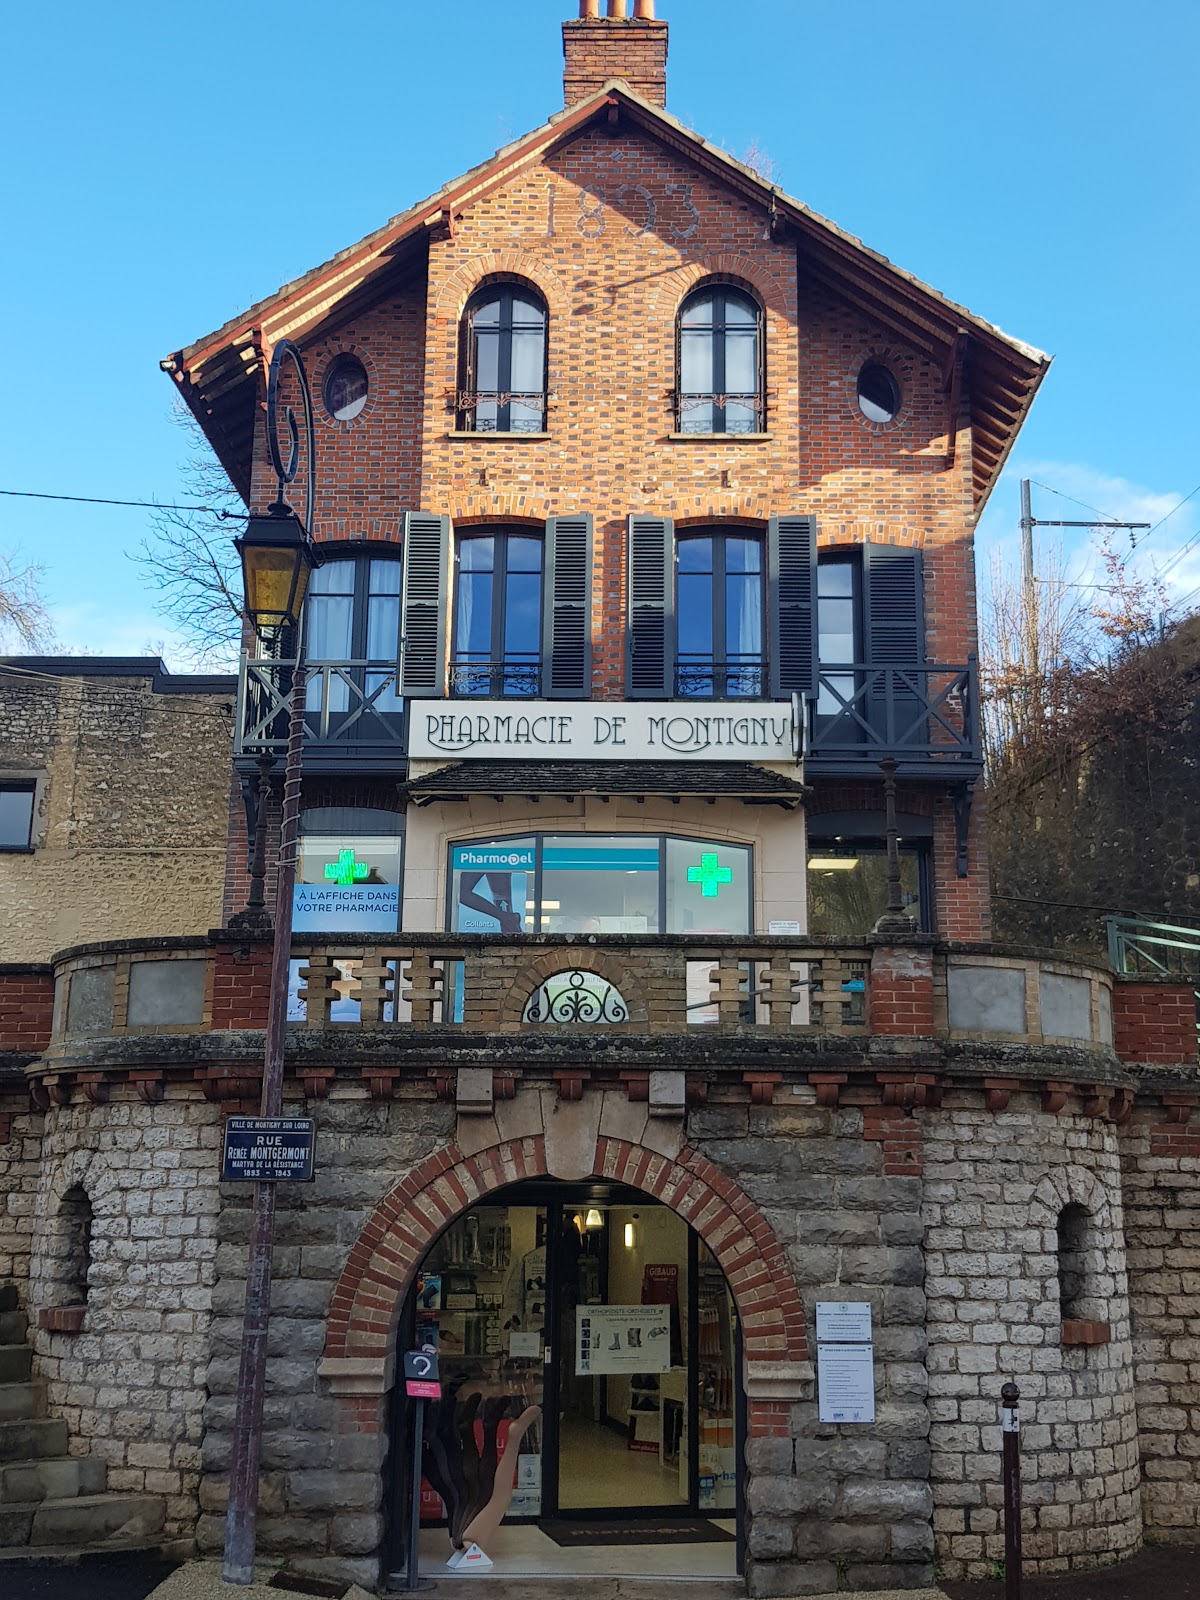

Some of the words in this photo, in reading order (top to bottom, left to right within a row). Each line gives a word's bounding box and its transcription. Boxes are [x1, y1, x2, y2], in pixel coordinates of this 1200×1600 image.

[425, 714, 573, 751] PHARMACIE
[593, 716, 627, 745] DE
[647, 716, 788, 754] MONTIGNY
[299, 889, 306, 900] À
[310, 891, 364, 900] L'AFFICHE
[367, 891, 397, 900] DANS
[296, 903, 332, 912] VOTRE
[335, 903, 399, 913] PHARMACIE
[231, 1120, 245, 1128] VILLE
[246, 1121, 254, 1129] DE
[254, 1121, 281, 1129] MONTIGNY
[294, 1122, 309, 1130] LOING
[256, 1136, 283, 1145] RUE
[250, 1147, 310, 1160] MONTGERMONT
[232, 1160, 254, 1168] MARTYR
[256, 1160, 263, 1168] DE
[265, 1160, 271, 1168] LA
[273, 1160, 304, 1168] RÉSISTANCE
[243, 1169, 260, 1177] 1893
[275, 1169, 291, 1177] 1943
[649, 1267, 677, 1276] GIBAUD
